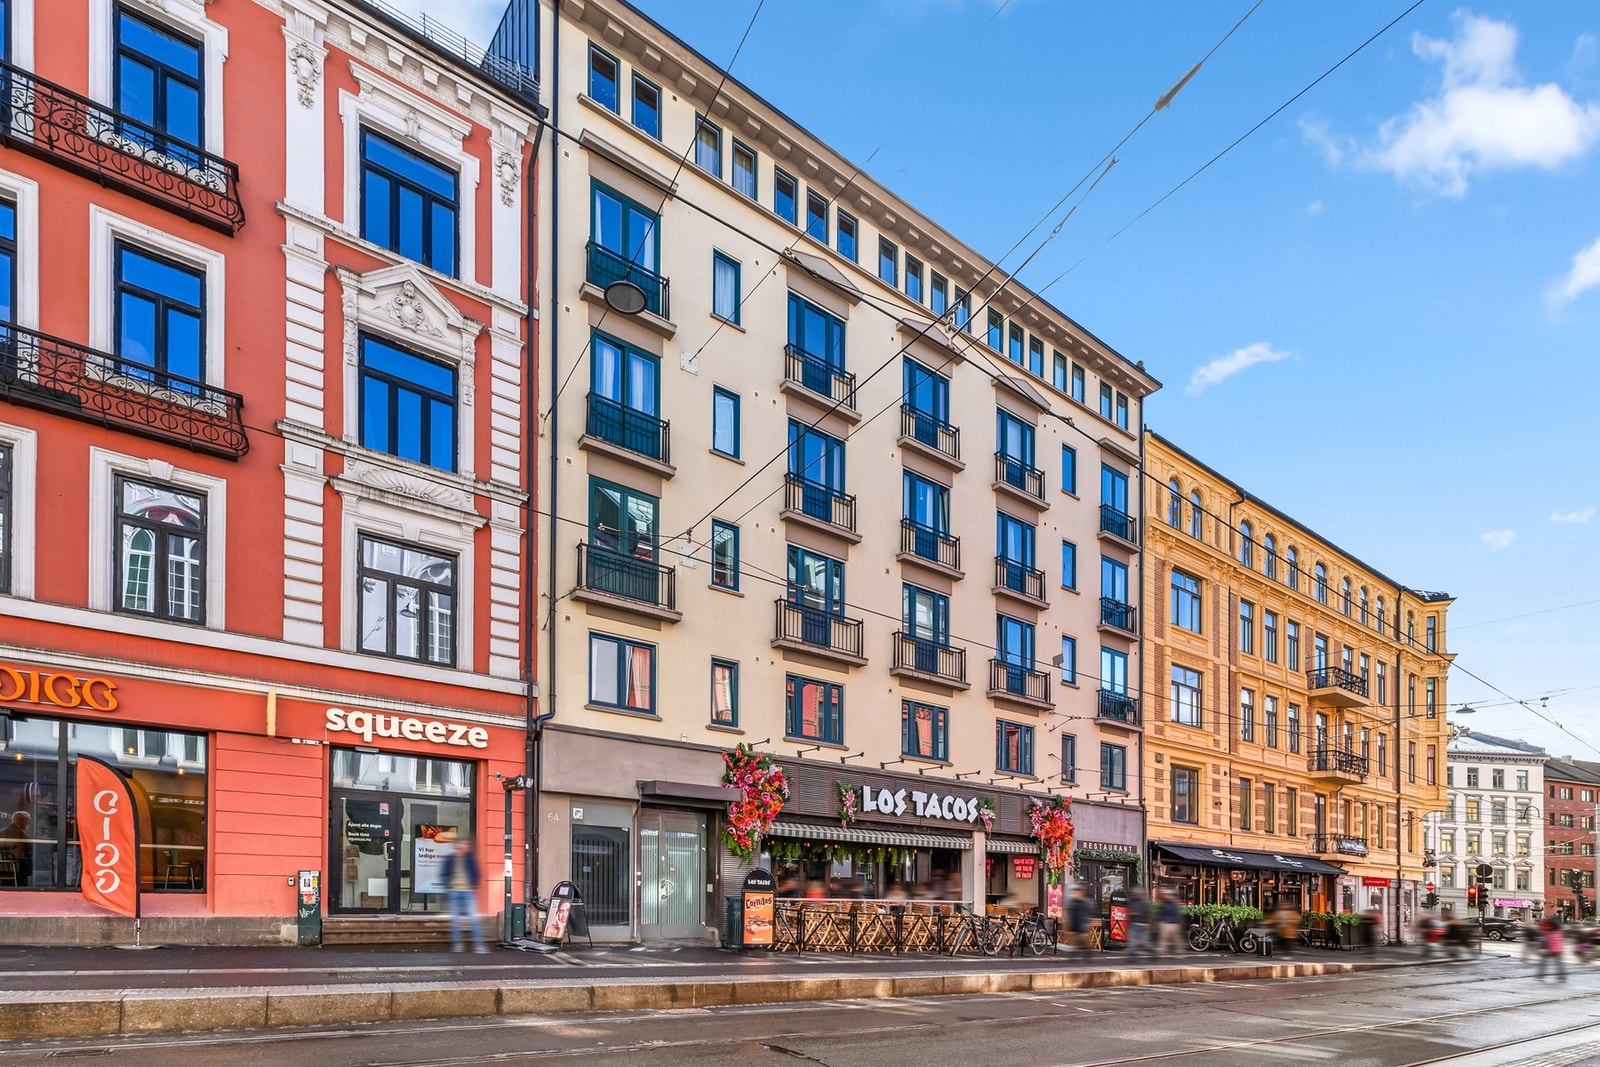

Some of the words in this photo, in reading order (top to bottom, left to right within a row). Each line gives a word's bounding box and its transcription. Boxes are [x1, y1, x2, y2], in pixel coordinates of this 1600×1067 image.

[0, 664, 119, 712] DIGG
[325, 707, 489, 749] squeeze
[547, 812, 560, 822] 64
[863, 784, 907, 816] LOS
[911, 791, 979, 823] TACOS
[1082, 841, 1133, 853] RESTAURANT
